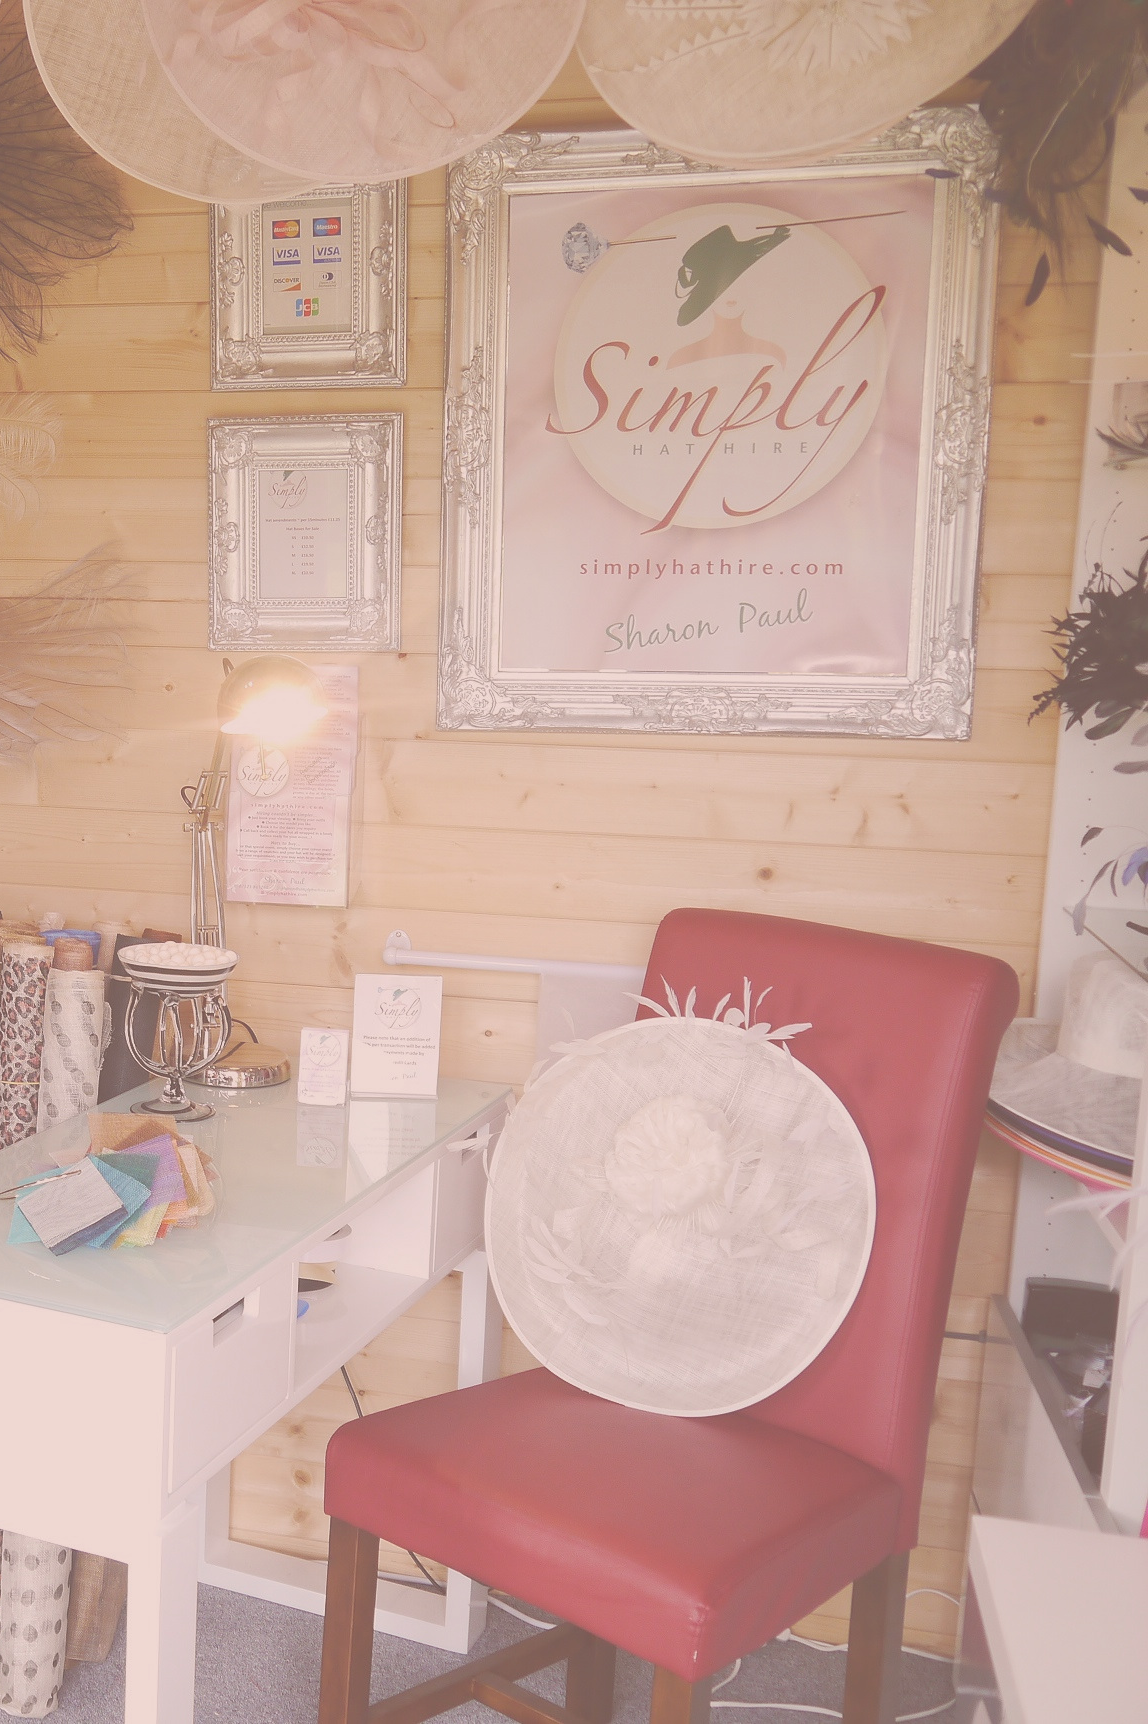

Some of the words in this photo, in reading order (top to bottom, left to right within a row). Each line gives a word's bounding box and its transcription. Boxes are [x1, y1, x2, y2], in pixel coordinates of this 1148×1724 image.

[277, 249, 300, 259] VISA
[317, 247, 340, 257] VISA
[545, 285, 886, 535] Simply
[633, 443, 695, 455] HAT
[725, 442, 807, 454] HIRE
[580, 559, 844, 580] simplyhathire.com
[604, 613, 719, 653] Sharon
[739, 588, 813, 633] Paul
[375, 998, 420, 1029] Simply
